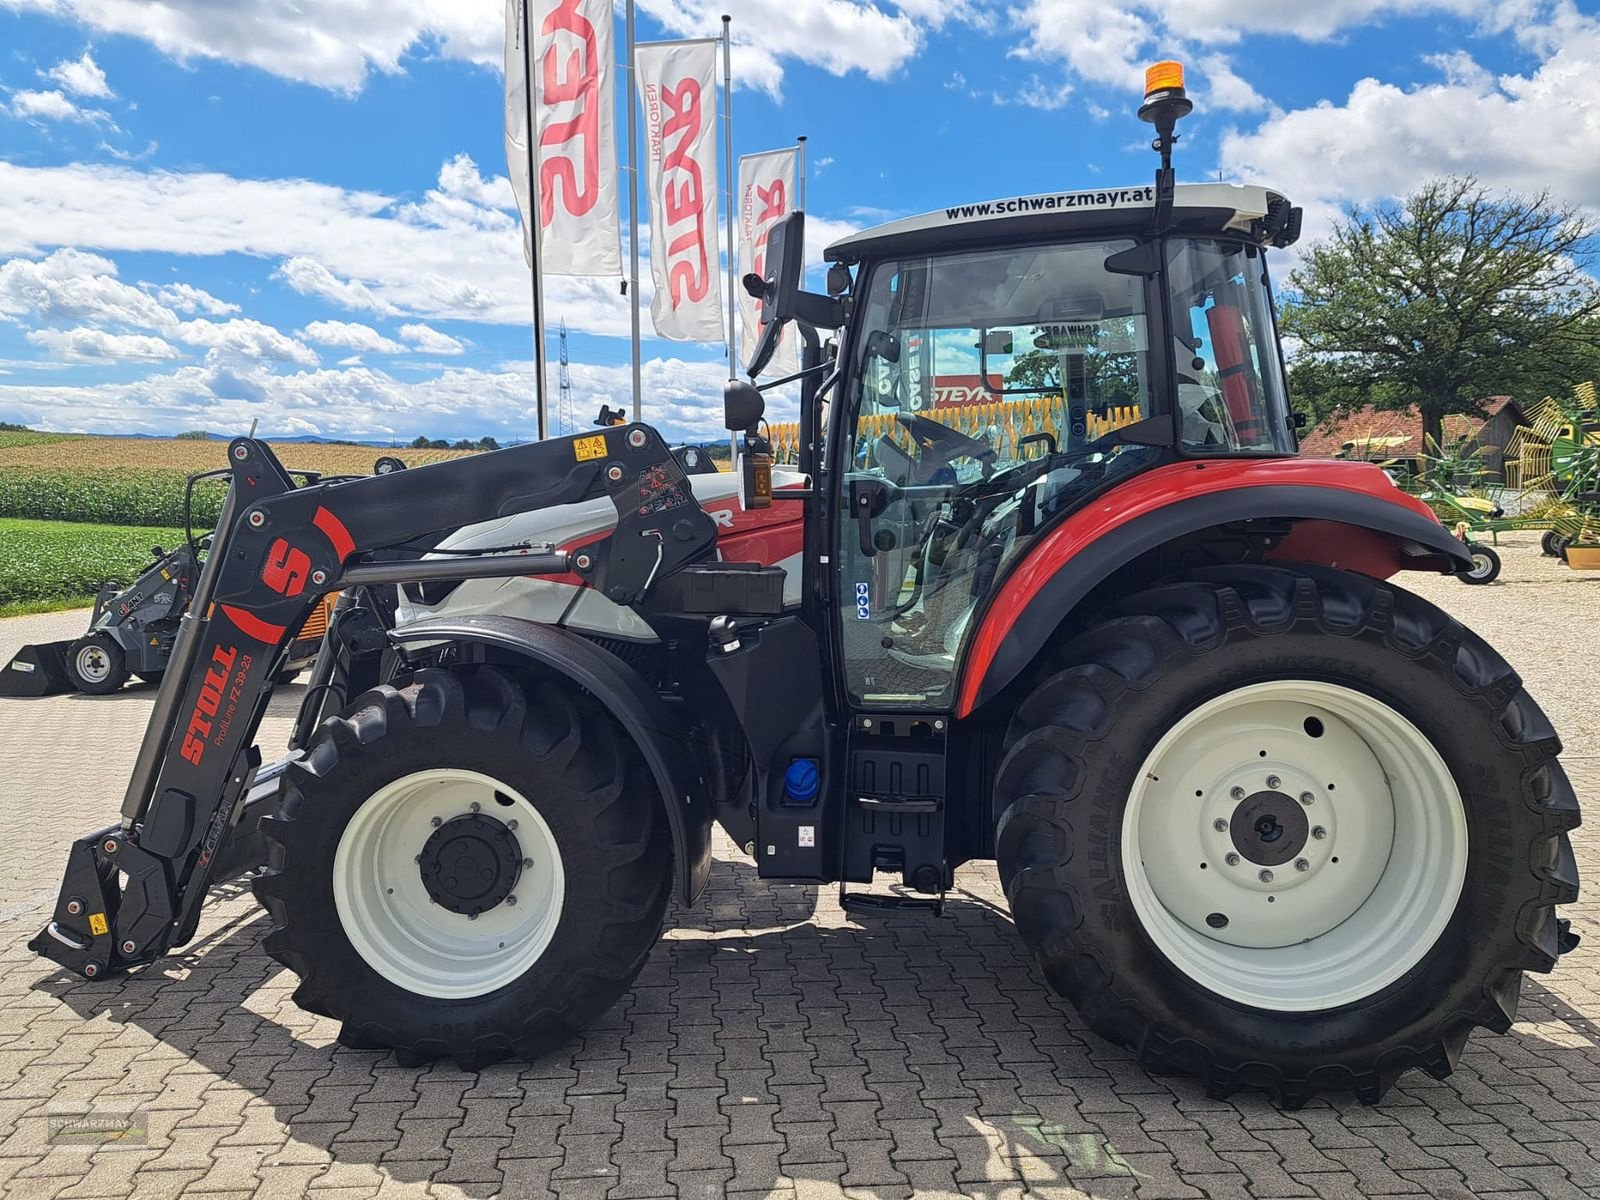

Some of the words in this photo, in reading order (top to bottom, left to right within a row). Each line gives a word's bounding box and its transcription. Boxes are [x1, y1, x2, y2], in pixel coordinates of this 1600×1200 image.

[946, 186, 1153, 220] www.schwarzmayr.at
[235, 654, 252, 688] 39-23
[179, 643, 238, 767] STOLL
[229, 686, 242, 703] FZ
